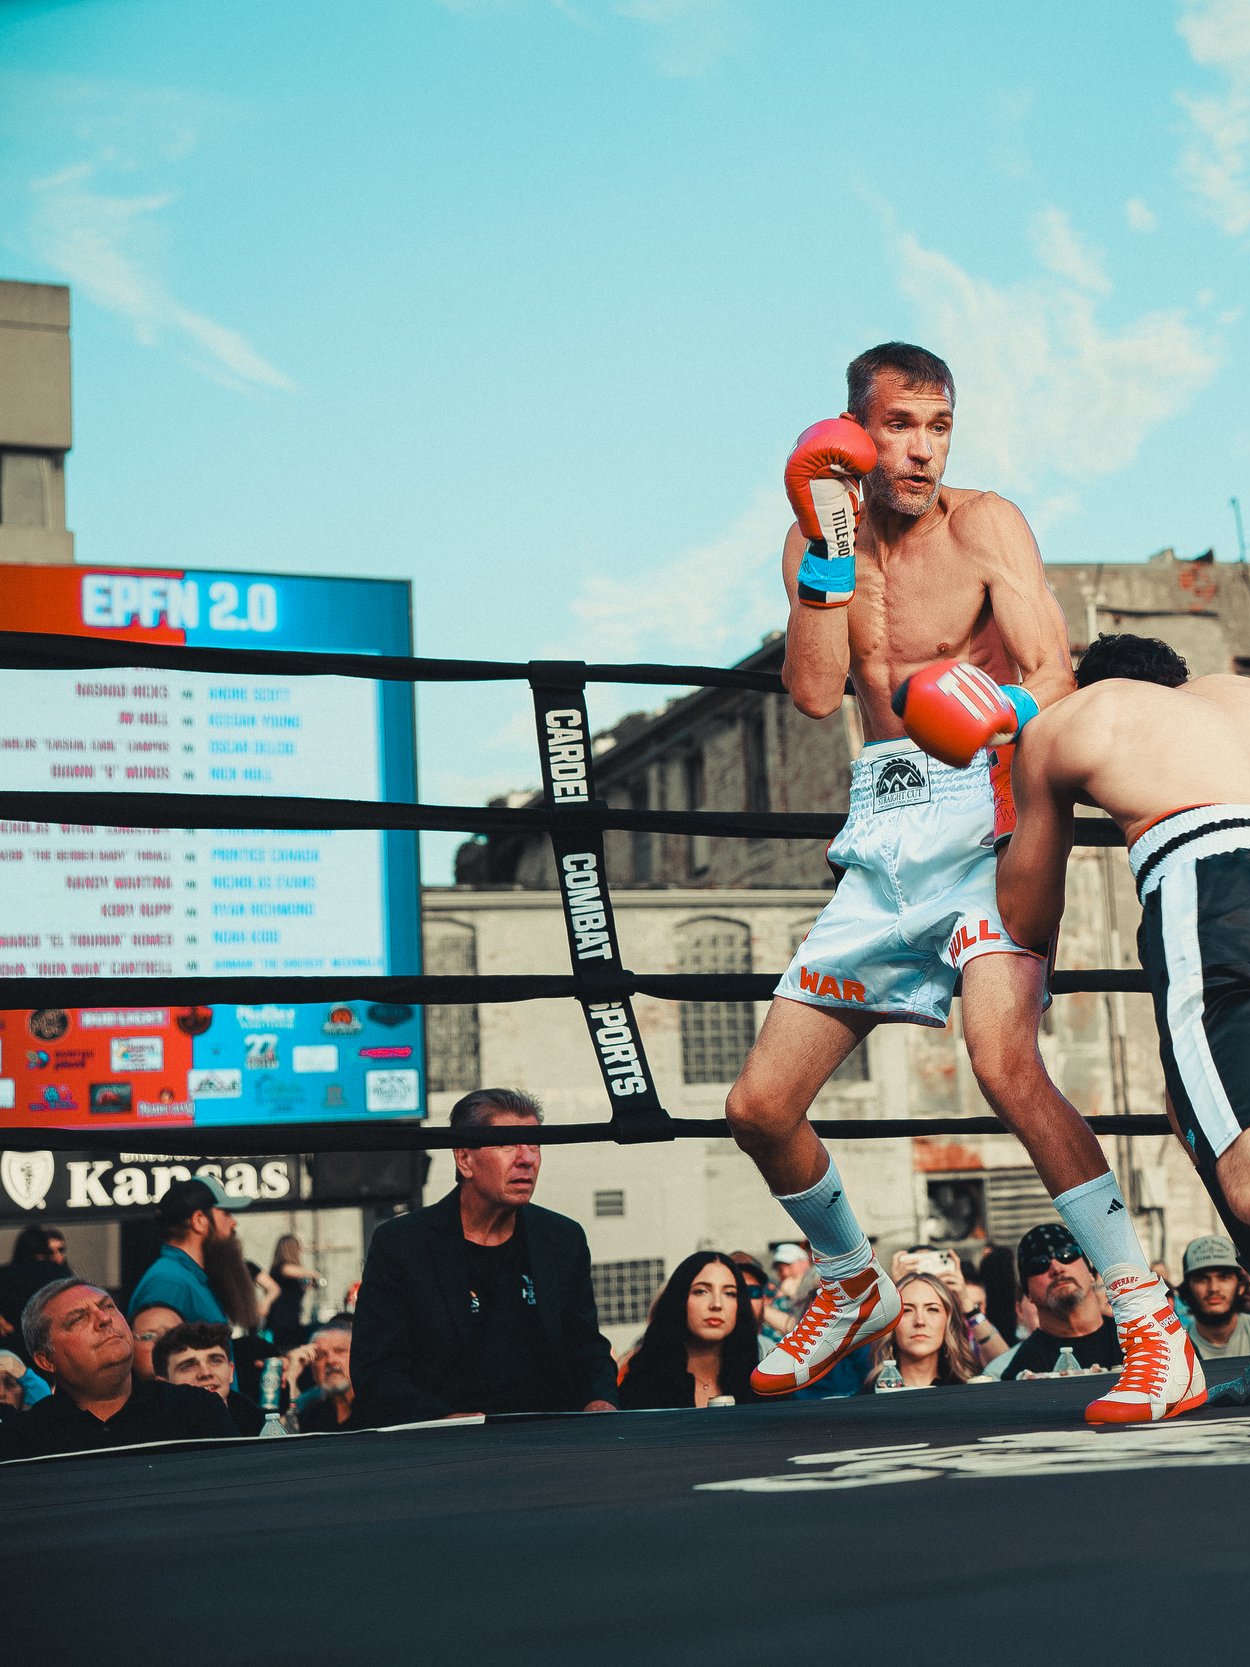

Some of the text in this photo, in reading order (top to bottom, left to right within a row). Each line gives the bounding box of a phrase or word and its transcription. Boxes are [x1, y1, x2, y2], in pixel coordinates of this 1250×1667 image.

[81, 574, 278, 632] EPFN 2.0
[906, 788, 922, 799] CUT
[562, 852, 613, 960] COMBAT
[799, 965, 866, 1003] WAR
